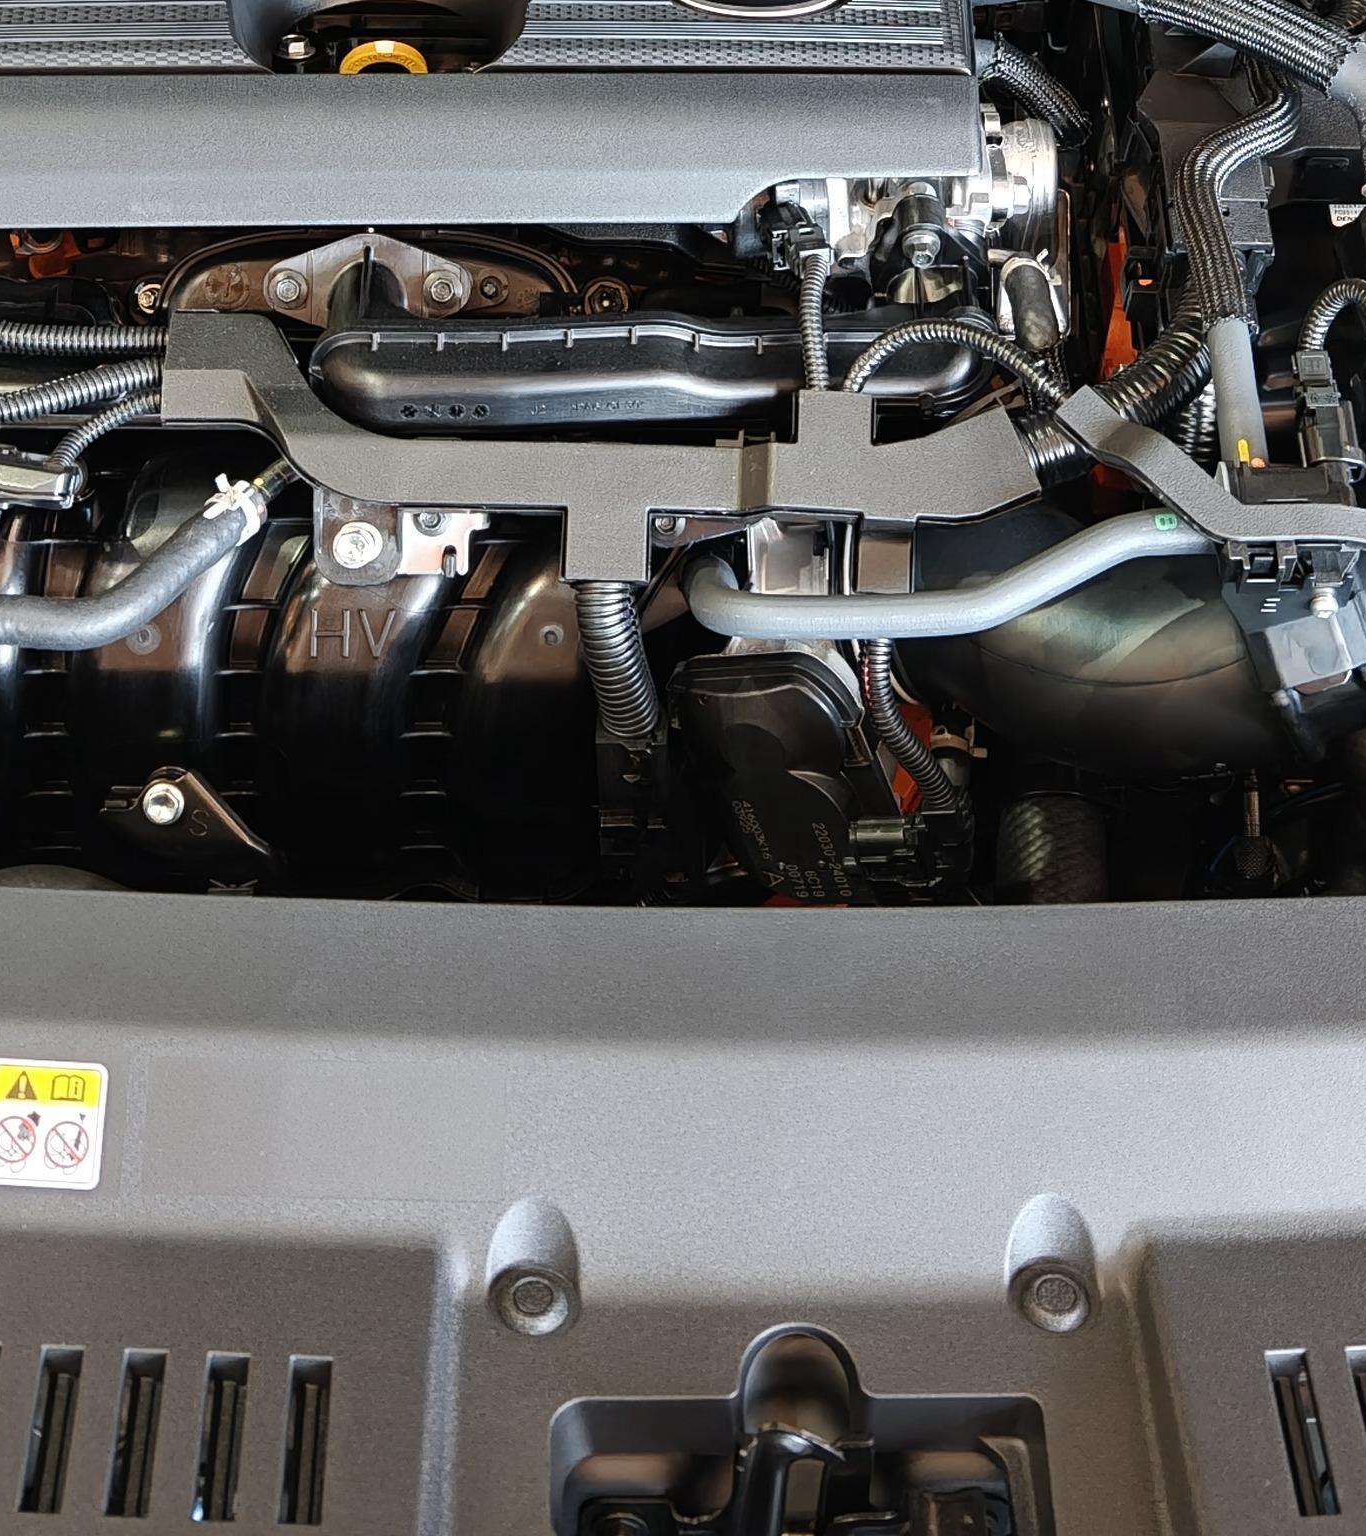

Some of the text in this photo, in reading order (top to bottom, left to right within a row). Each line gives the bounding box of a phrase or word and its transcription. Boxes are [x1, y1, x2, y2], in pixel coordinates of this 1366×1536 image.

[310, 608, 396, 658] HV
[189, 809, 211, 836] S
[762, 870, 785, 887] A
[811, 822, 852, 897] 22030-24010
